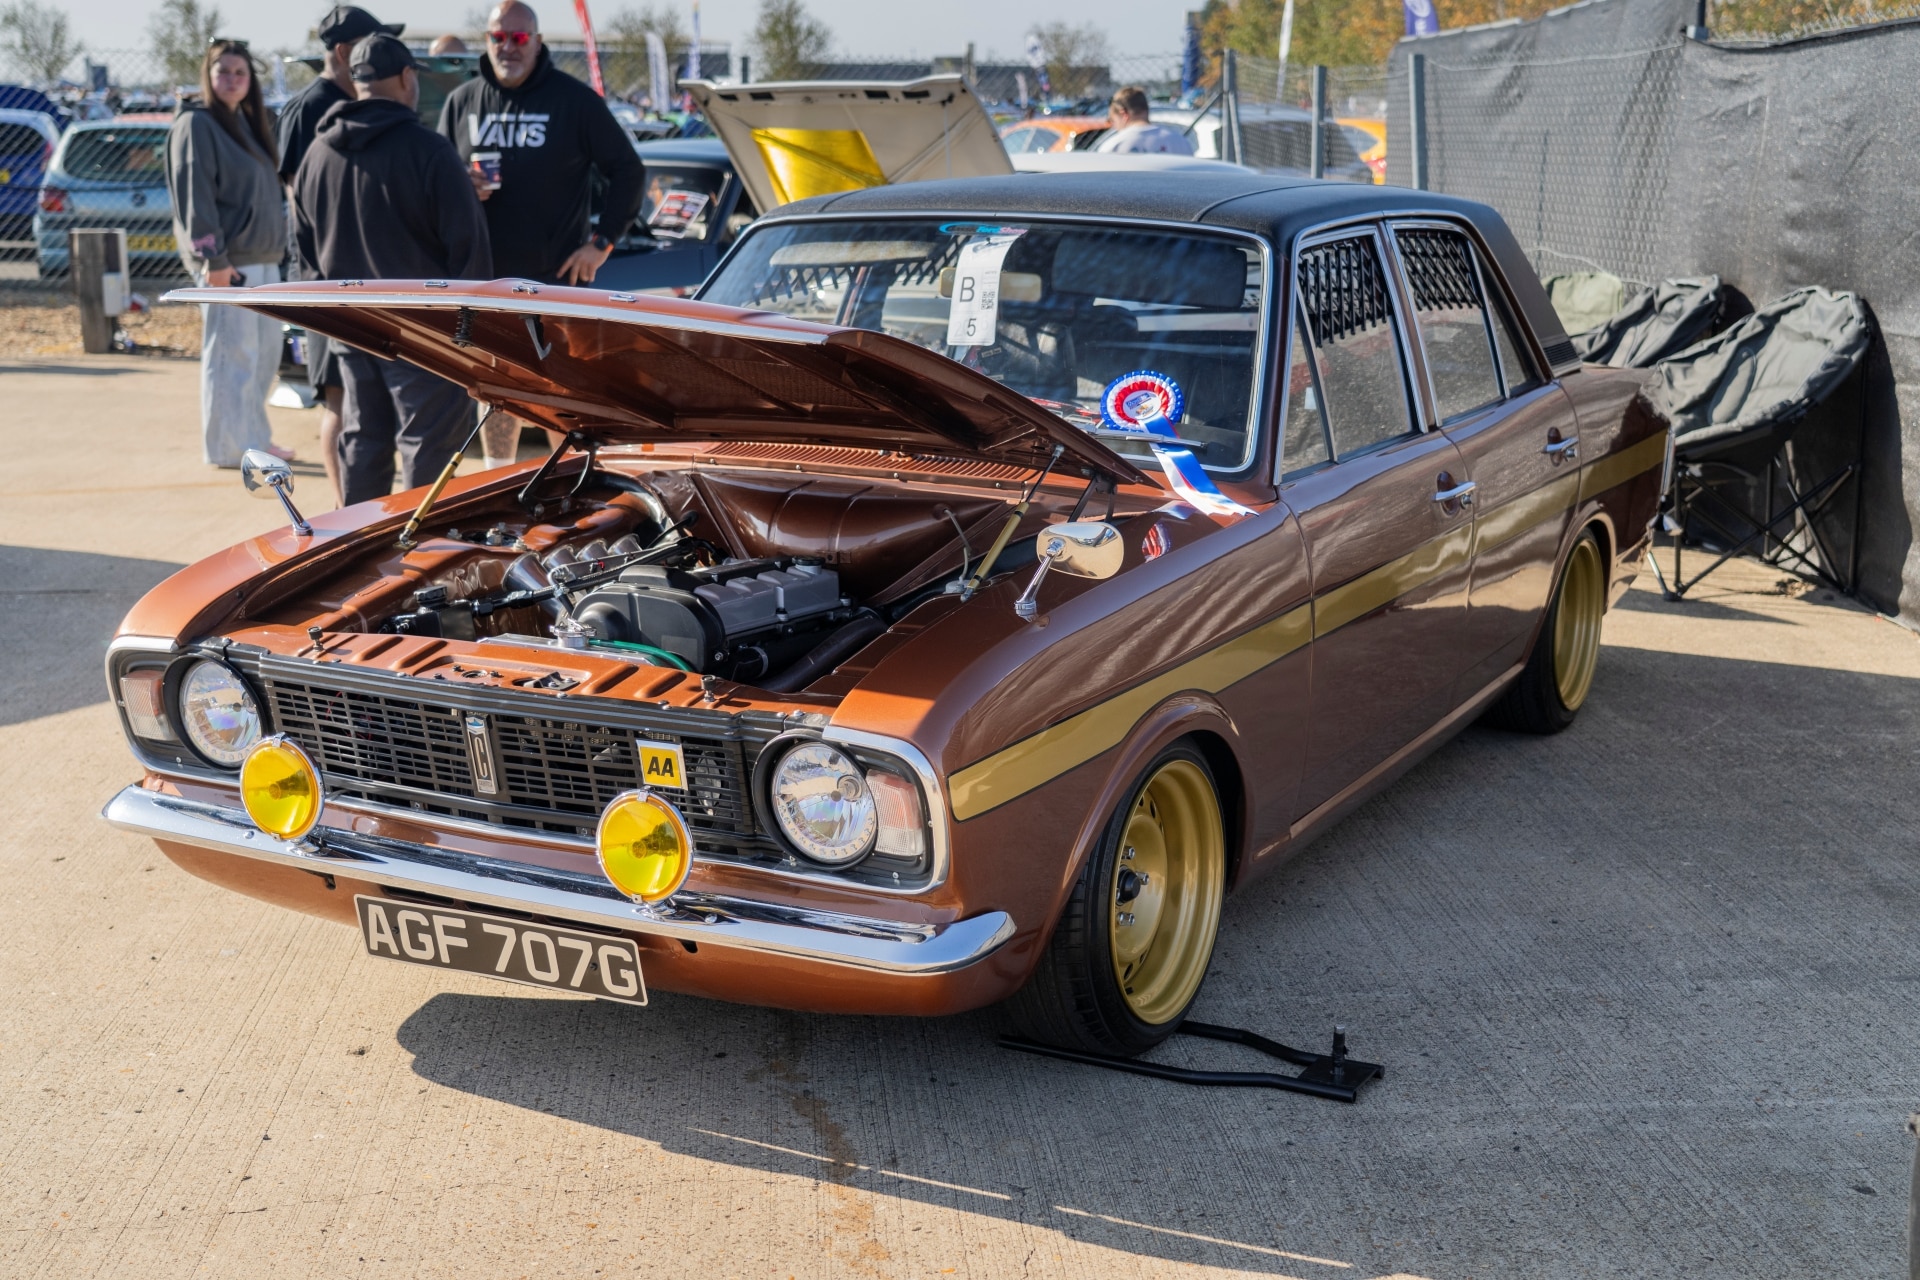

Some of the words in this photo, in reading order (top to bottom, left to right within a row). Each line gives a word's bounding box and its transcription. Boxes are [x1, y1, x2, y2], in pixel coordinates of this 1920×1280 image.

[468, 113, 550, 148] VANS
[960, 276, 976, 303] B
[966, 317, 977, 337] 5
[647, 756, 675, 778] AA
[367, 903, 469, 964] AGF
[482, 922, 639, 997] 707G
